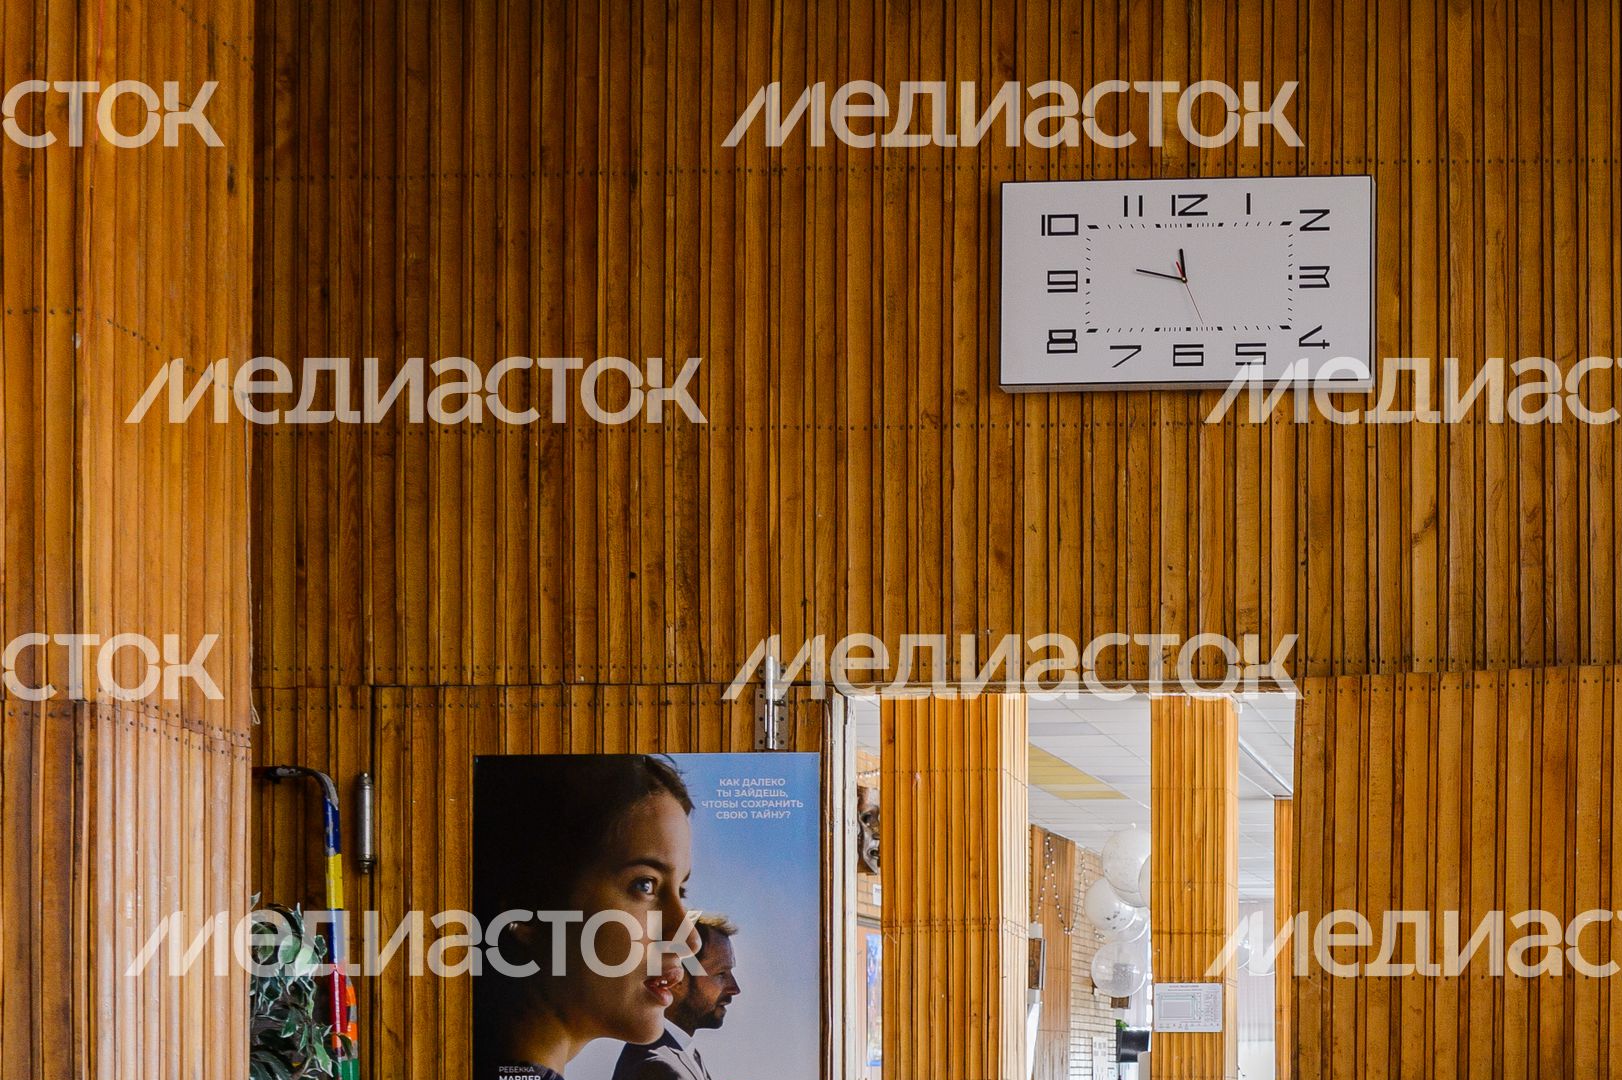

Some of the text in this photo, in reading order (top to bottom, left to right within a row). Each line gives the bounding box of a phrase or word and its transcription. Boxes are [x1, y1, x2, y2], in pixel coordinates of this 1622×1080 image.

[1123, 195, 1143, 217] 11
[1171, 194, 1208, 216] 12
[1246, 193, 1251, 215] 1
[1041, 214, 1079, 236] 10
[1299, 209, 1330, 231] 2
[1047, 270, 1078, 293] 9
[1299, 266, 1330, 288] 3
[1047, 329, 1078, 354] 8
[1299, 325, 1330, 349] 4
[1109, 345, 1142, 368] 7
[1173, 343, 1204, 366] 6
[1235, 342, 1267, 366] 5
[716, 788, 788, 798] ТЫ ЗАЙДЕШЬ,
[719, 778, 786, 787] КАК ДАЛЕКО
[701, 800, 804, 808] ЧТОБЫ СОХРАНИТЬ
[716, 809, 791, 819] СВОЮ ТАЙНУ?
